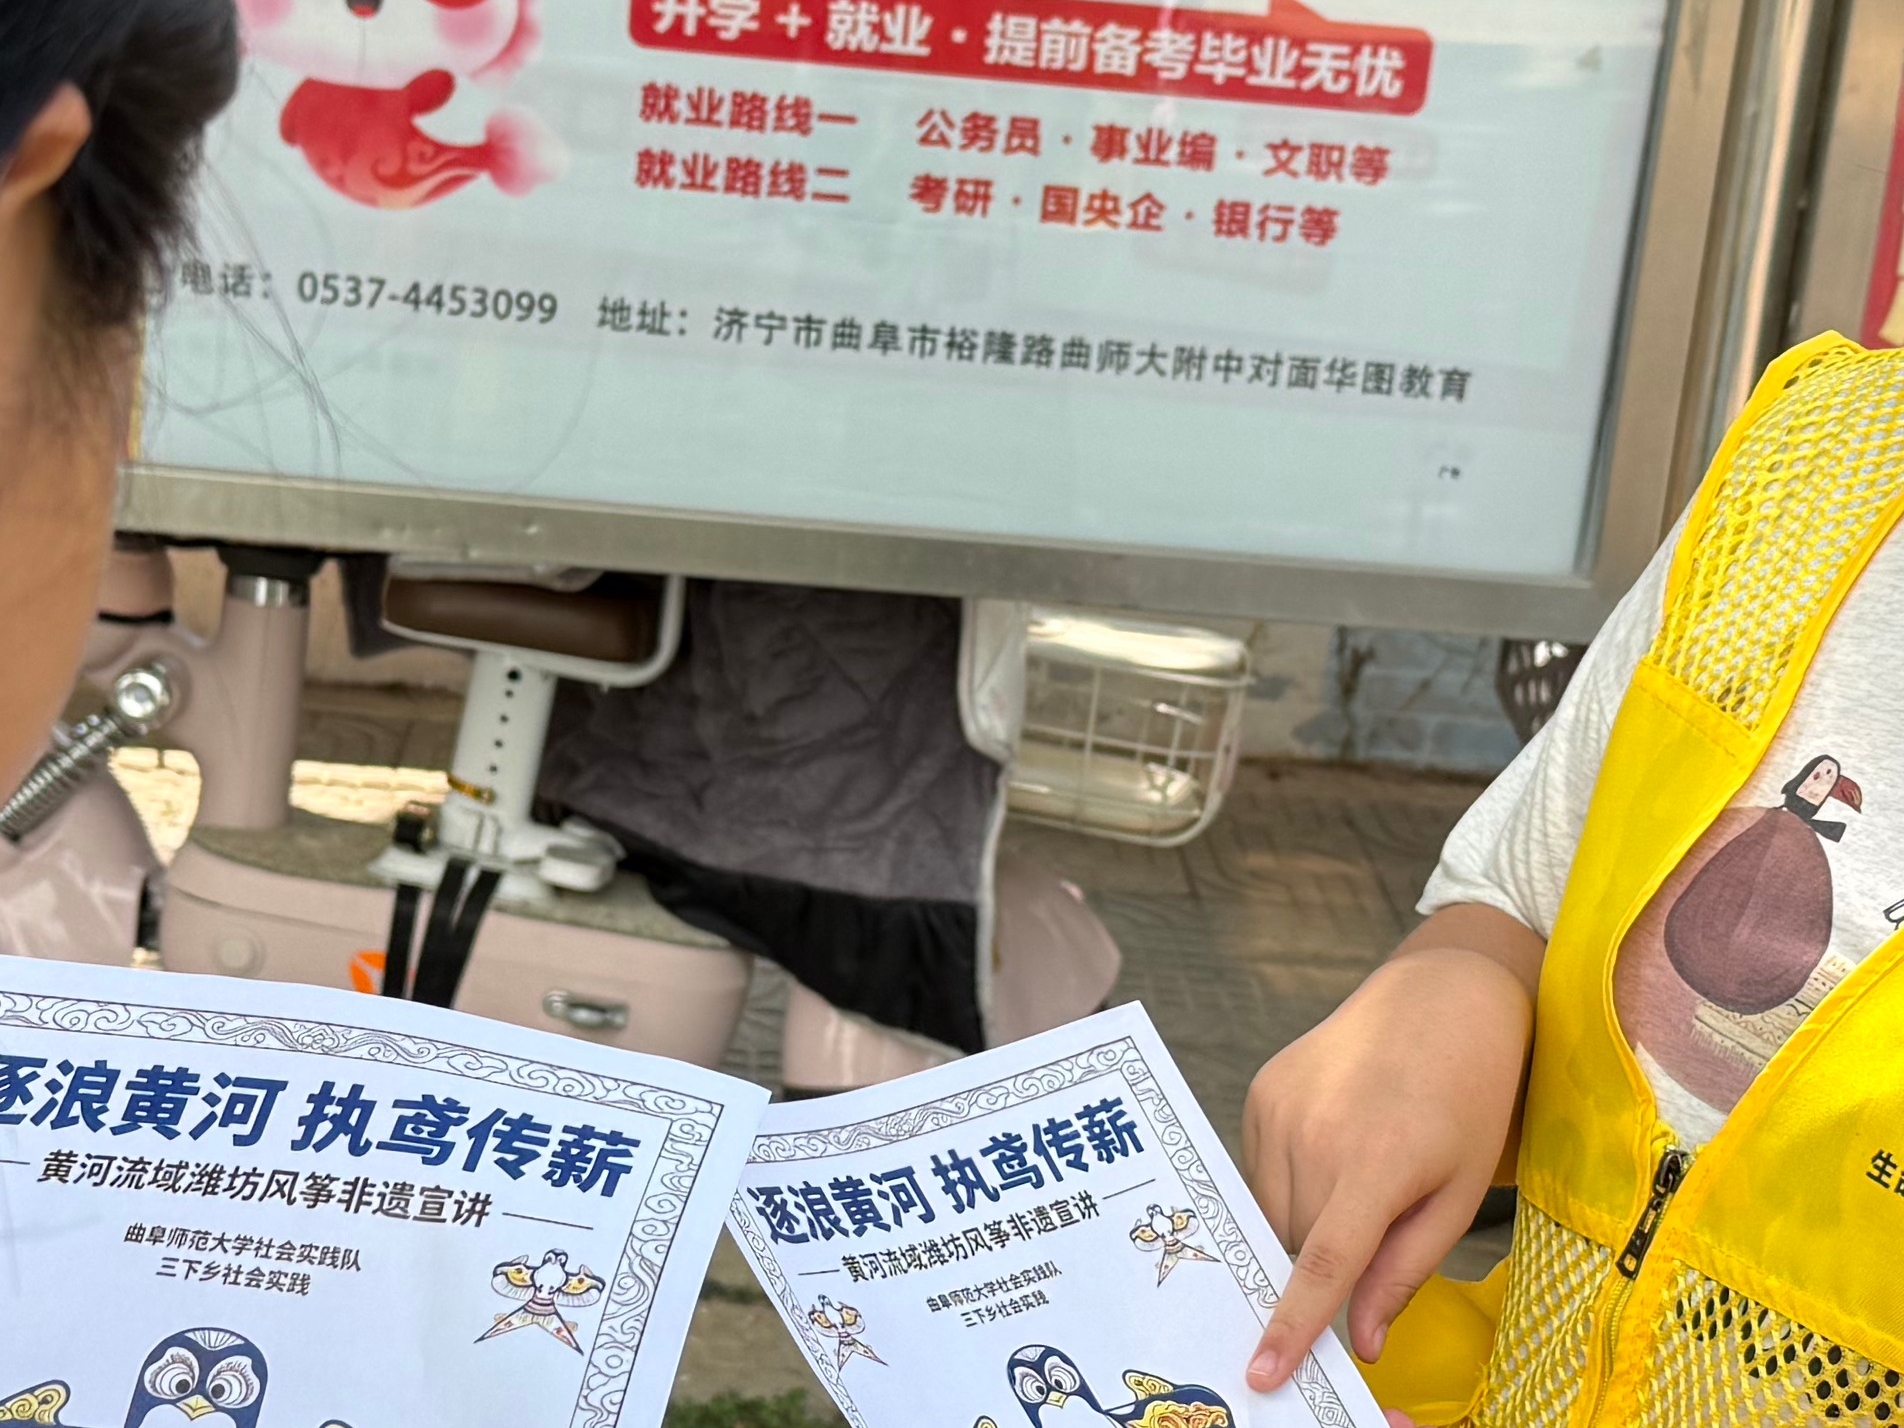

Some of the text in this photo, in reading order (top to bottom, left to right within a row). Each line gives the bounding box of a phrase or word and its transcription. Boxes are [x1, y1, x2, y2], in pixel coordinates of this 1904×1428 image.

[638, 82, 1390, 188] 就业路线一 公务员·事业编·文职等
[634, 148, 1340, 247] 就业路线二 考研·国央企·银行等
[290, 1080, 642, 1201] 执鸢传薪
[747, 1096, 1145, 1246] 逐浪黄河 执鸢传薪
[37, 1149, 494, 1229] 黄河流域潍坊风筝非遗宣讲
[123, 1222, 362, 1272] 曲阜师范大学社会实践队
[156, 1257, 312, 1296] 三下乡社会实践
[841, 1190, 1100, 1283] 黄河流域潍坊风筝非遗宣讲
[926, 1259, 1063, 1314] 曲阜师范大学社会实践队
[960, 1290, 1050, 1329] 三下乡社会实践
